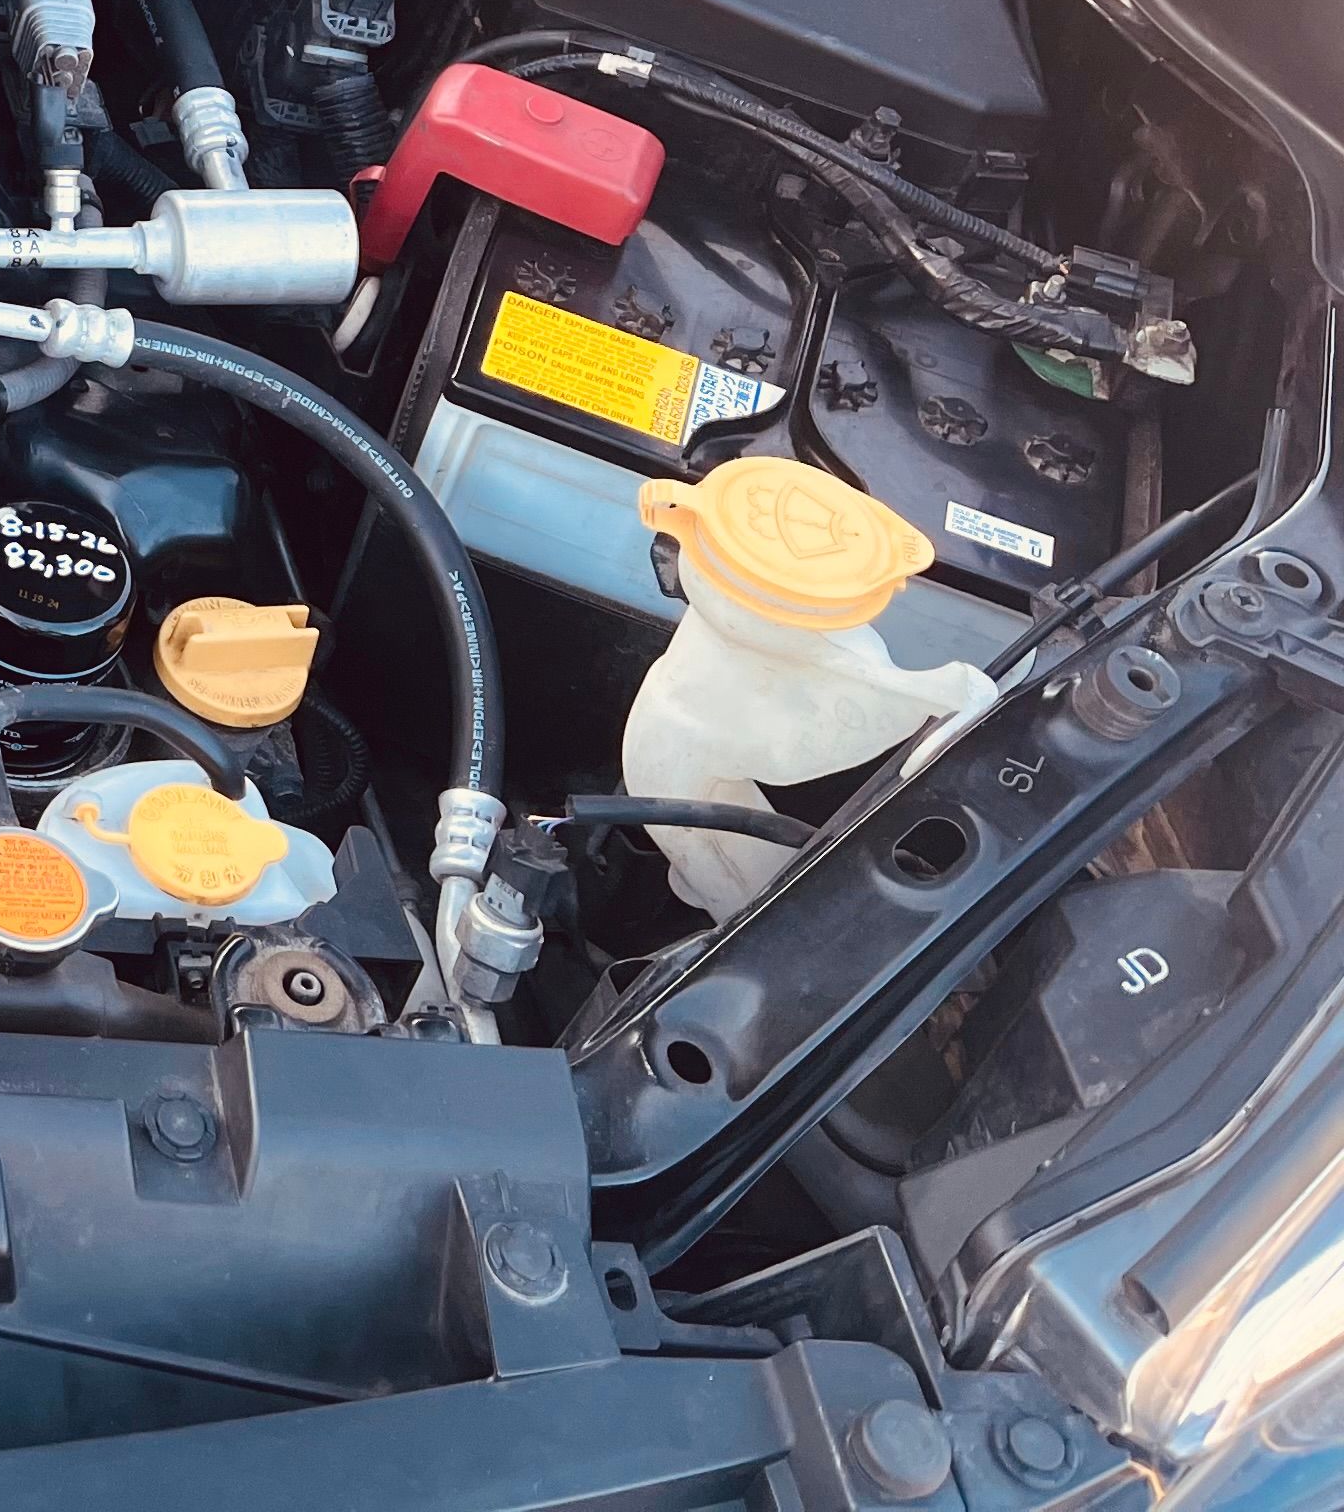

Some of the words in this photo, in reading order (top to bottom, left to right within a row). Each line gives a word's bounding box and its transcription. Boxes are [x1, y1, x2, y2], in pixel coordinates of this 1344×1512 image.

[29, 239, 41, 254] A
[507, 295, 562, 322] DANGER
[564, 317, 608, 338] EXPLOSIVE
[609, 333, 637, 349] GASES
[493, 337, 548, 365] POISON
[550, 359, 583, 378] CAUSES
[584, 371, 615, 388] SEVERE
[616, 382, 646, 401] BURNS
[507, 330, 529, 343] KEEP
[529, 336, 551, 352] VENT
[551, 342, 574, 359] CAPS
[575, 352, 600, 370] TIGHT
[601, 362, 620, 377] AND
[620, 370, 646, 387] LEVEL
[495, 368, 517, 385] KEEP
[518, 375, 536, 390] OUT
[536, 382, 548, 393] OF
[549, 387, 578, 405] REACH
[578, 397, 590, 409] OF
[591, 402, 635, 426] CHILDREN
[698, 366, 720, 397] START
[691, 402, 711, 428] STOP
[4, 542, 116, 582] 82,300
[1031, 545, 1042, 558] U
[999, 755, 1045, 793] SL
[1117, 947, 1170, 995] JD
